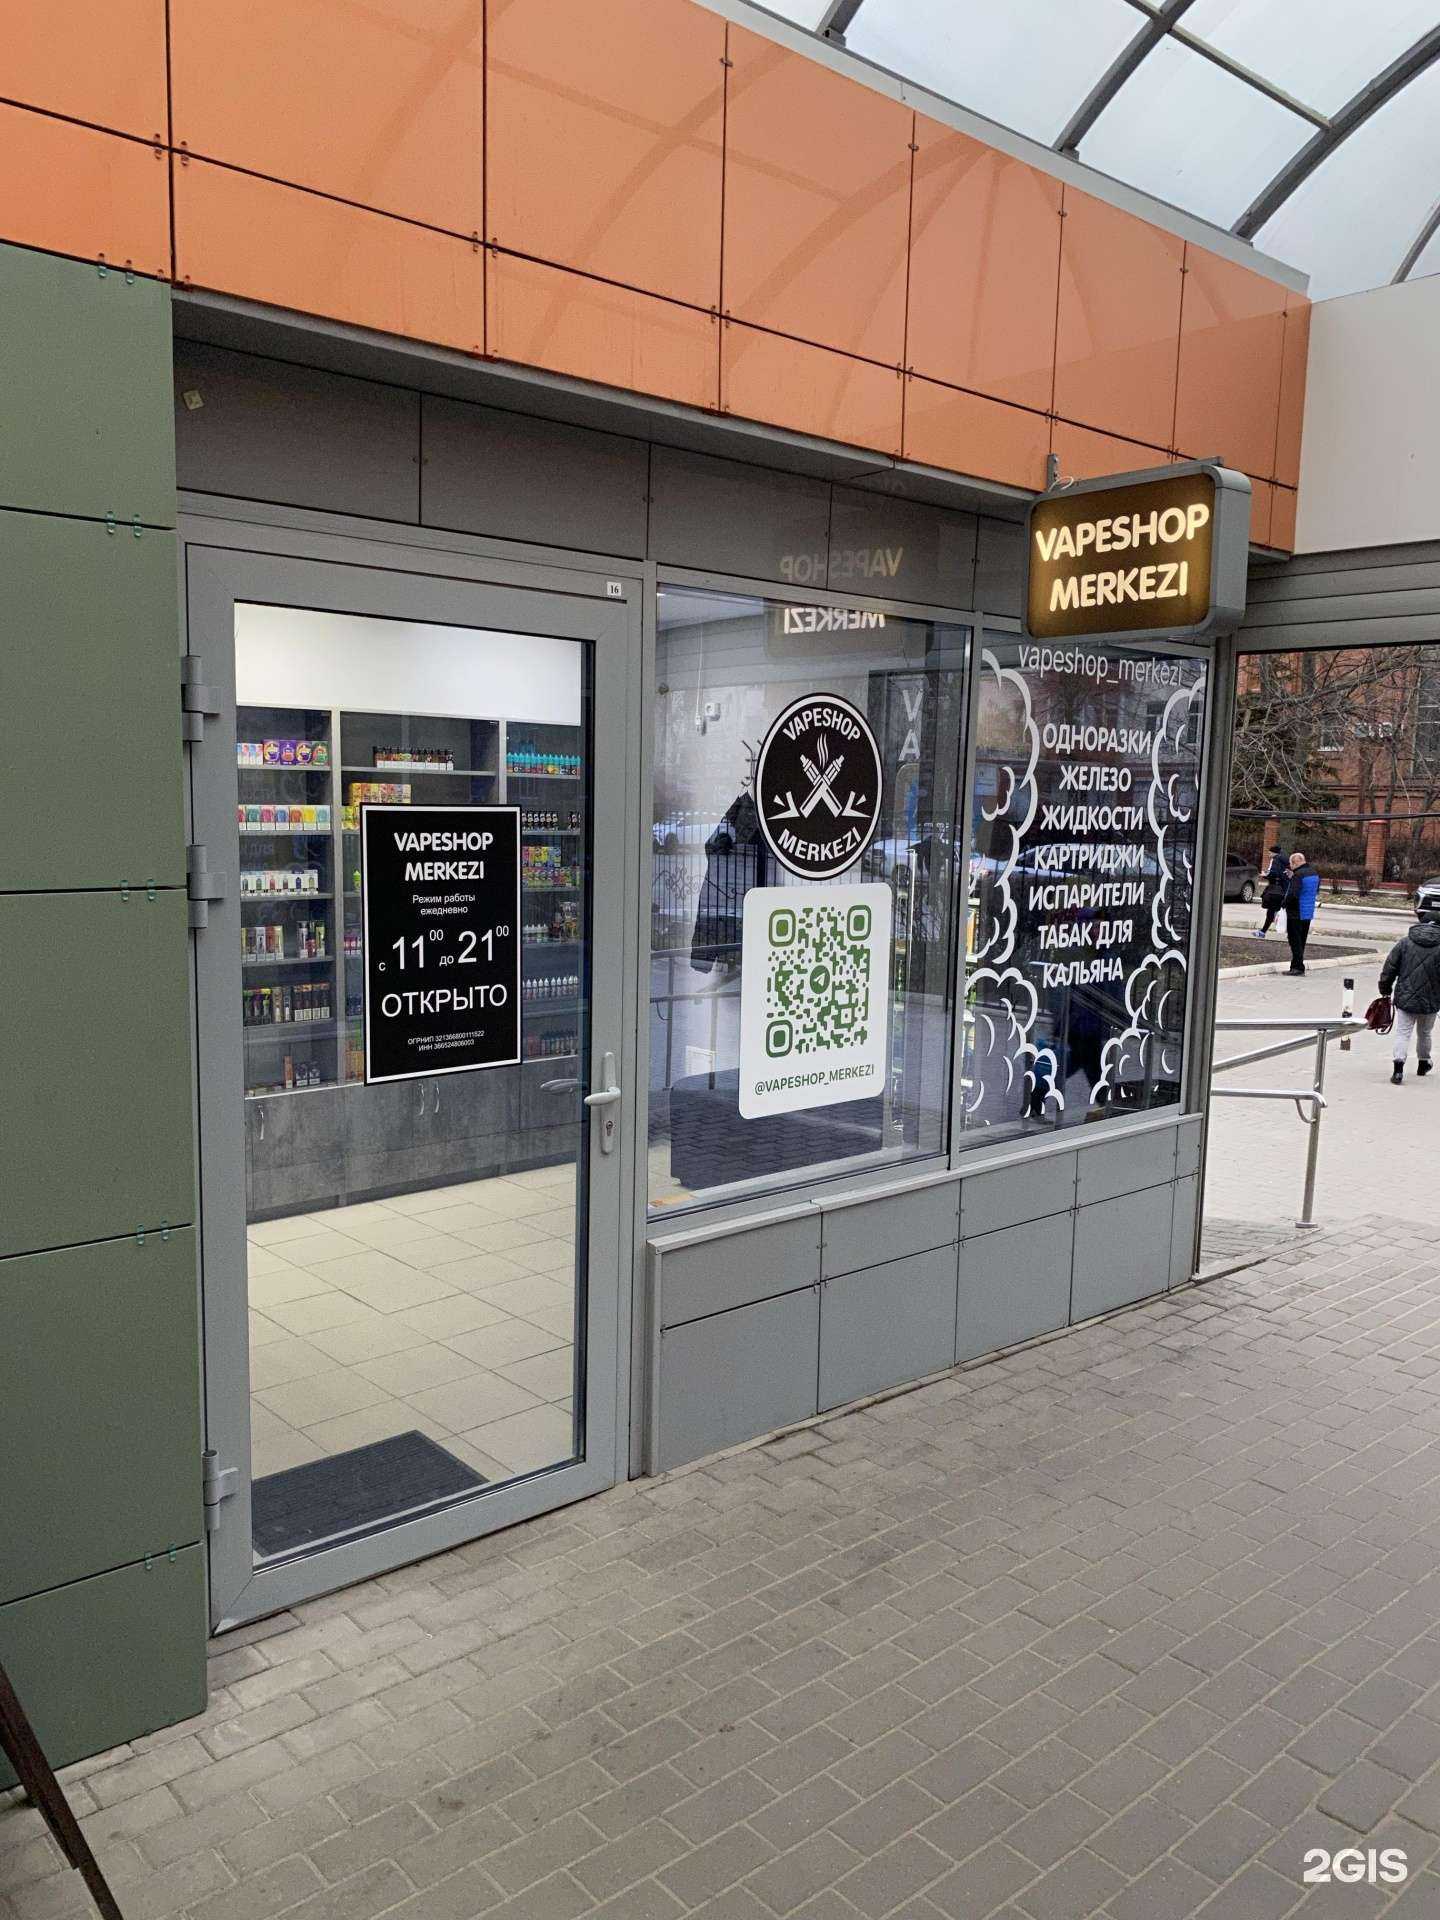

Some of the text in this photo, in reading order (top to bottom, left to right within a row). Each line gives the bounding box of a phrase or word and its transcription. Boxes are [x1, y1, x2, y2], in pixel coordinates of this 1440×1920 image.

[1035, 503, 1210, 562] VAPESHOP
[610, 585, 619, 594] 16
[1049, 560, 1189, 612] MERKEZI
[1018, 644, 1182, 687] vapeshop_merkezi
[782, 707, 861, 741] VAPESHOP
[1042, 722, 1151, 755] ОДНОРАЗКИ
[1058, 765, 1132, 793] ЖЕЛЕЗО
[1040, 804, 1144, 836] ЖИДКОСТИ
[394, 832, 493, 852] VAPESHOP
[777, 826, 862, 862] MERKEZI
[404, 861, 485, 881] MERKEZI
[1033, 844, 1145, 872] КАРТРИДЖИ
[412, 893, 476, 905] Режим работы
[420, 906, 468, 916] ежедневно
[1028, 881, 1145, 912] ИСПАРИТЕЛИ
[1038, 919, 1133, 950] ТАБАК ДЛЯ
[439, 955, 454, 967] до
[1042, 956, 1124, 989] КАЛЬЯНА
[381, 984, 508, 1018] ОТКРЫТО
[754, 1064, 874, 1095] @VAPESHOP_MERKEZI
